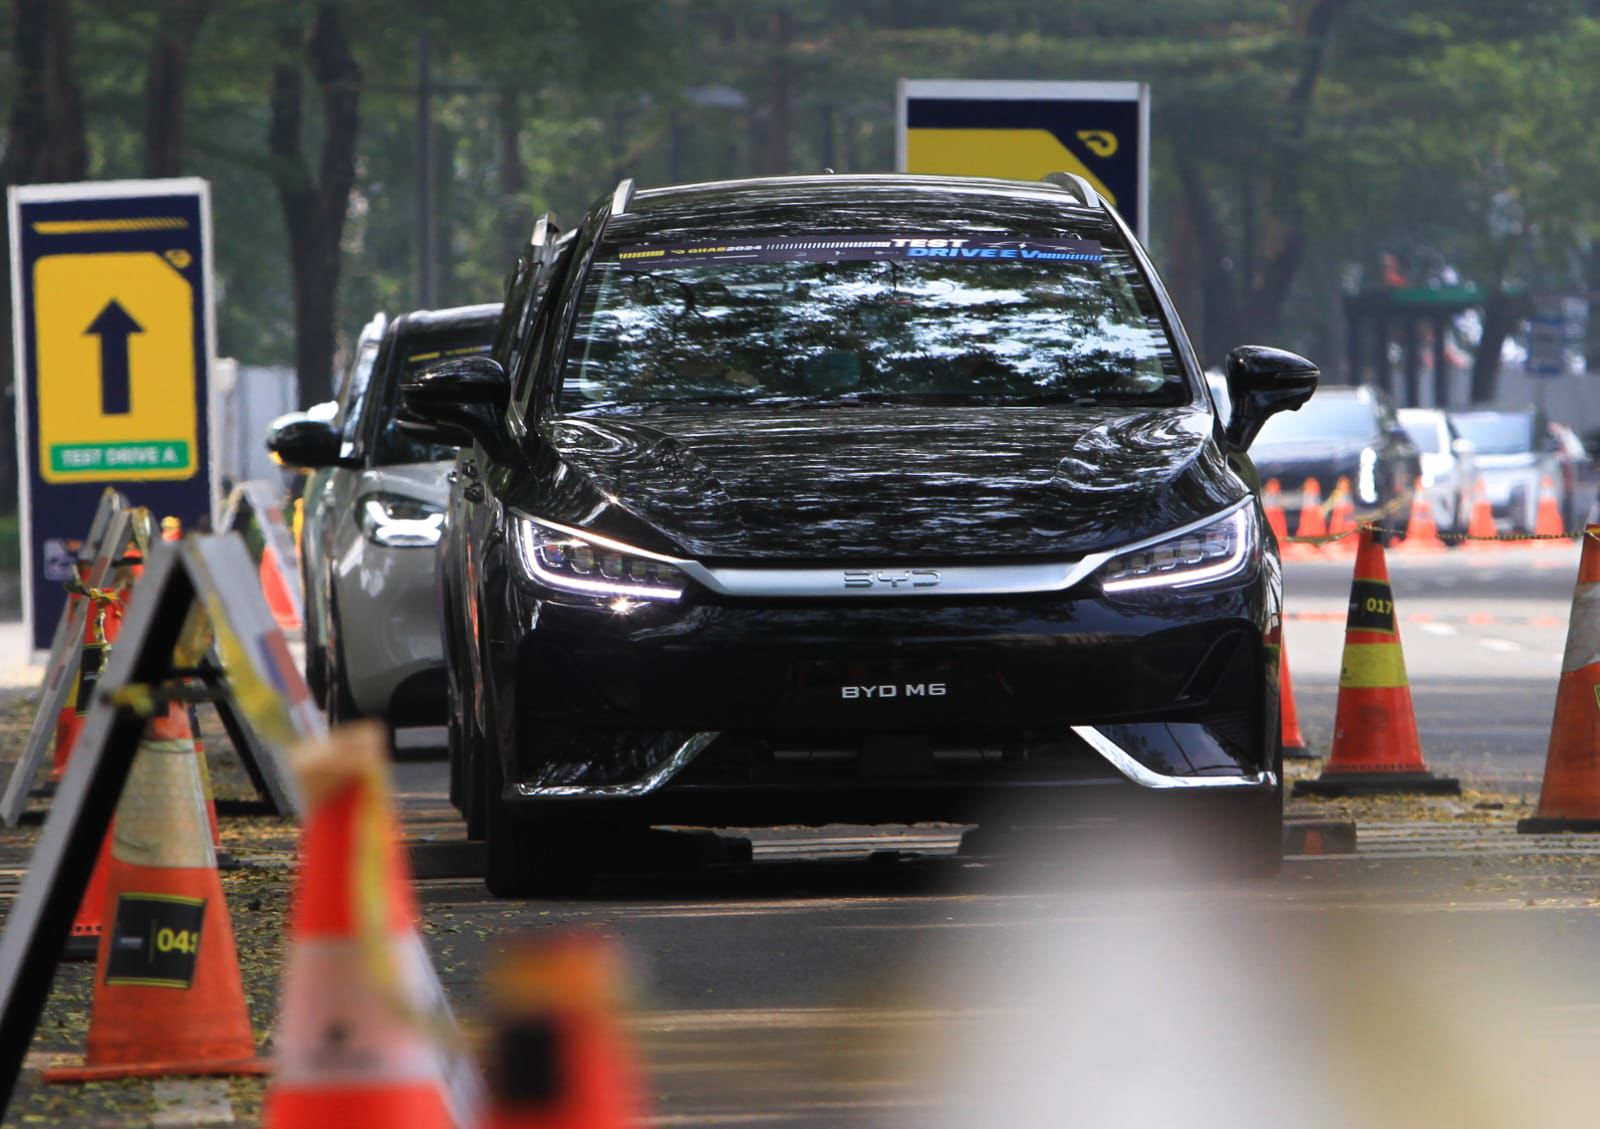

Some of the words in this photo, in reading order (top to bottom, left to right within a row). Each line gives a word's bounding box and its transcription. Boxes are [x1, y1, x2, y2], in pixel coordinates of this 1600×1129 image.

[891, 238, 969, 248] TEST
[907, 247, 999, 258] DRIVE
[62, 448, 103, 467] TEST
[105, 446, 160, 465] DRIVE
[162, 446, 179, 464] A
[843, 570, 942, 588] BYD
[1366, 597, 1393, 615] 017
[841, 685, 897, 699] BYD
[905, 683, 947, 697] M6
